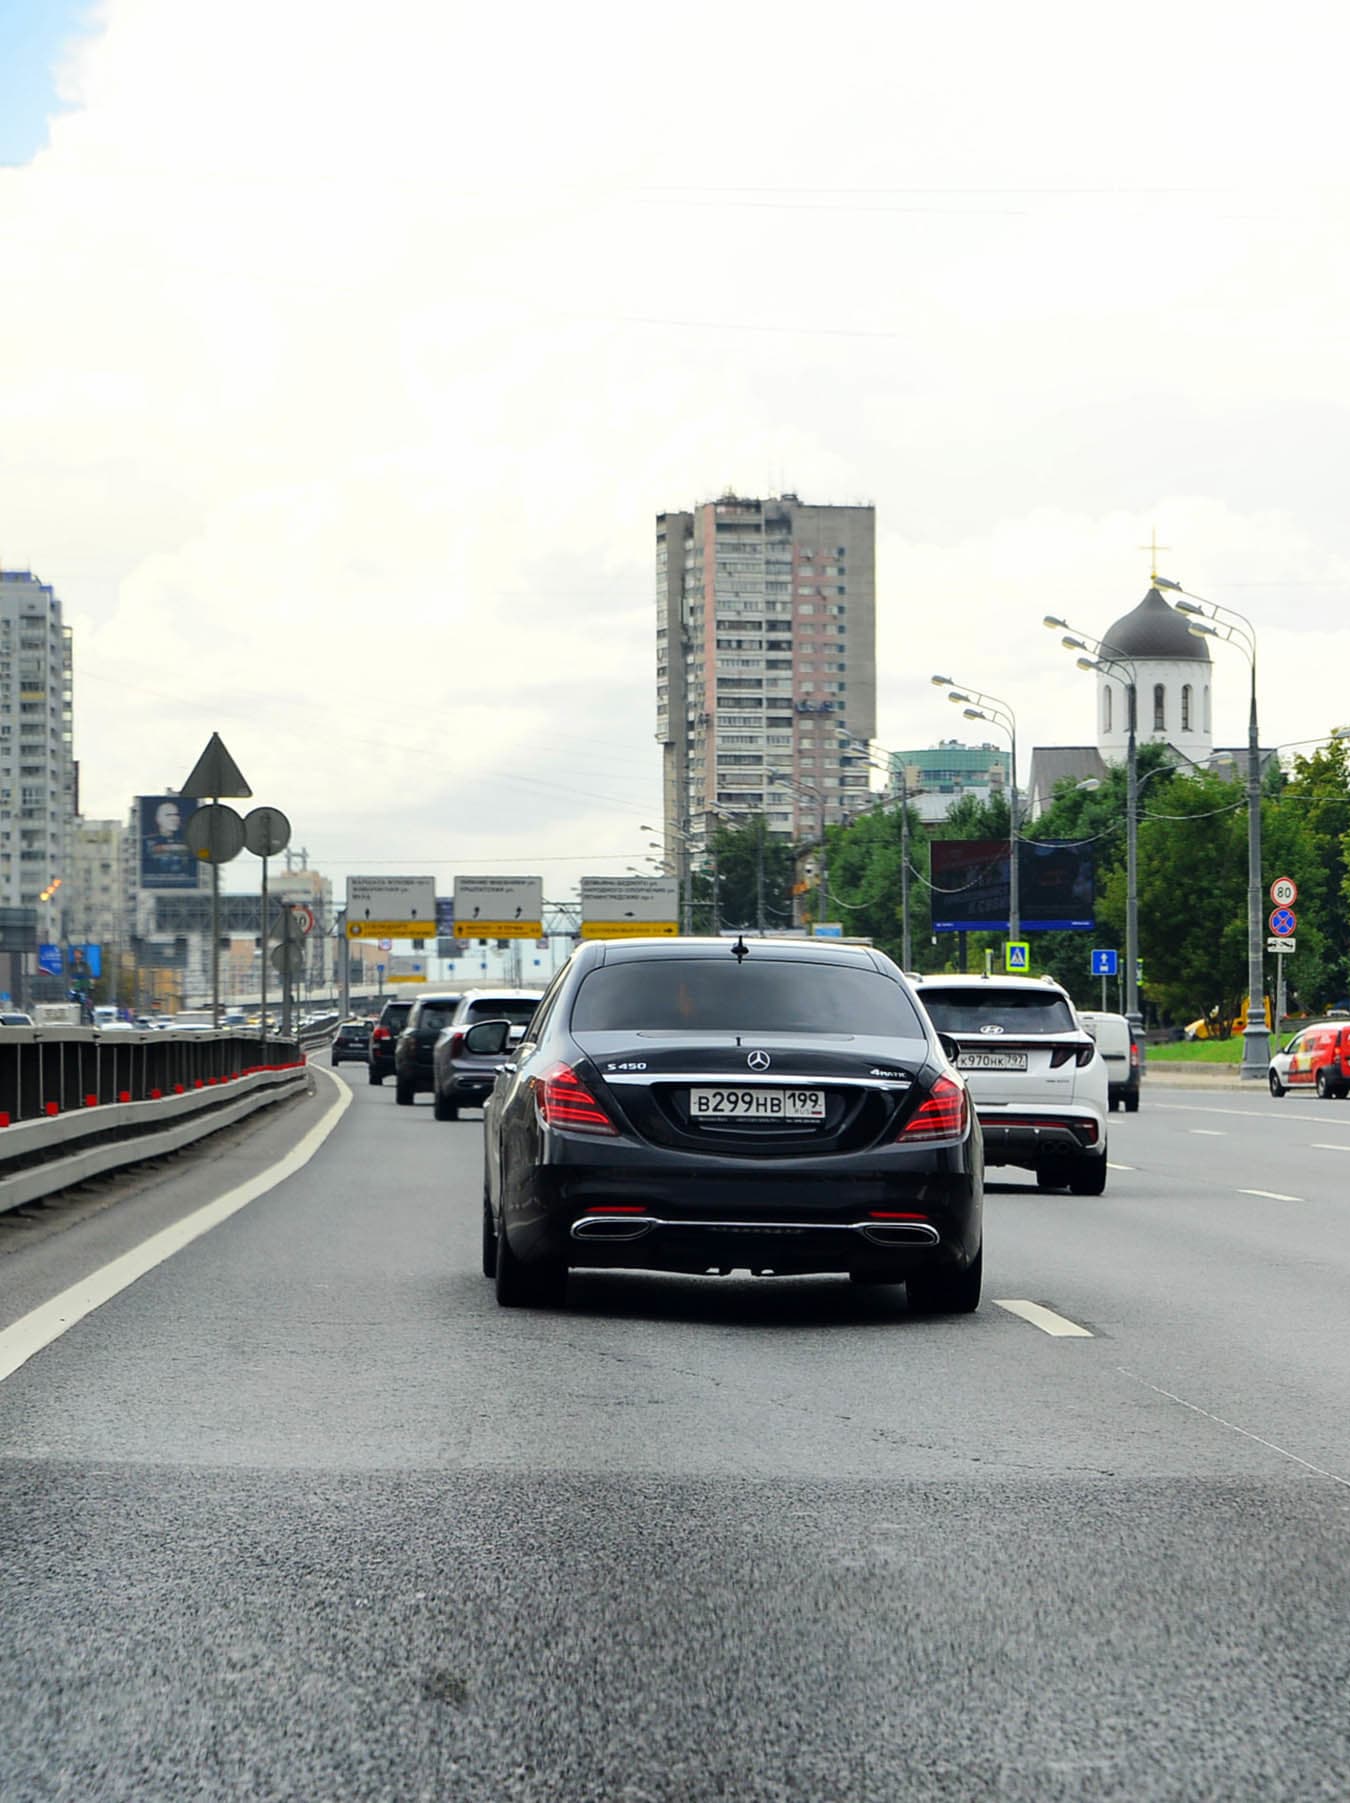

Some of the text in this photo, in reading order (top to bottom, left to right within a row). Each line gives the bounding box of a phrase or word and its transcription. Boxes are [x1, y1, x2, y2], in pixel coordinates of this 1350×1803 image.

[1277, 886, 1292, 898] 80
[607, 1062, 647, 1071] S 450
[698, 1091, 819, 1113] В299НВ 199
